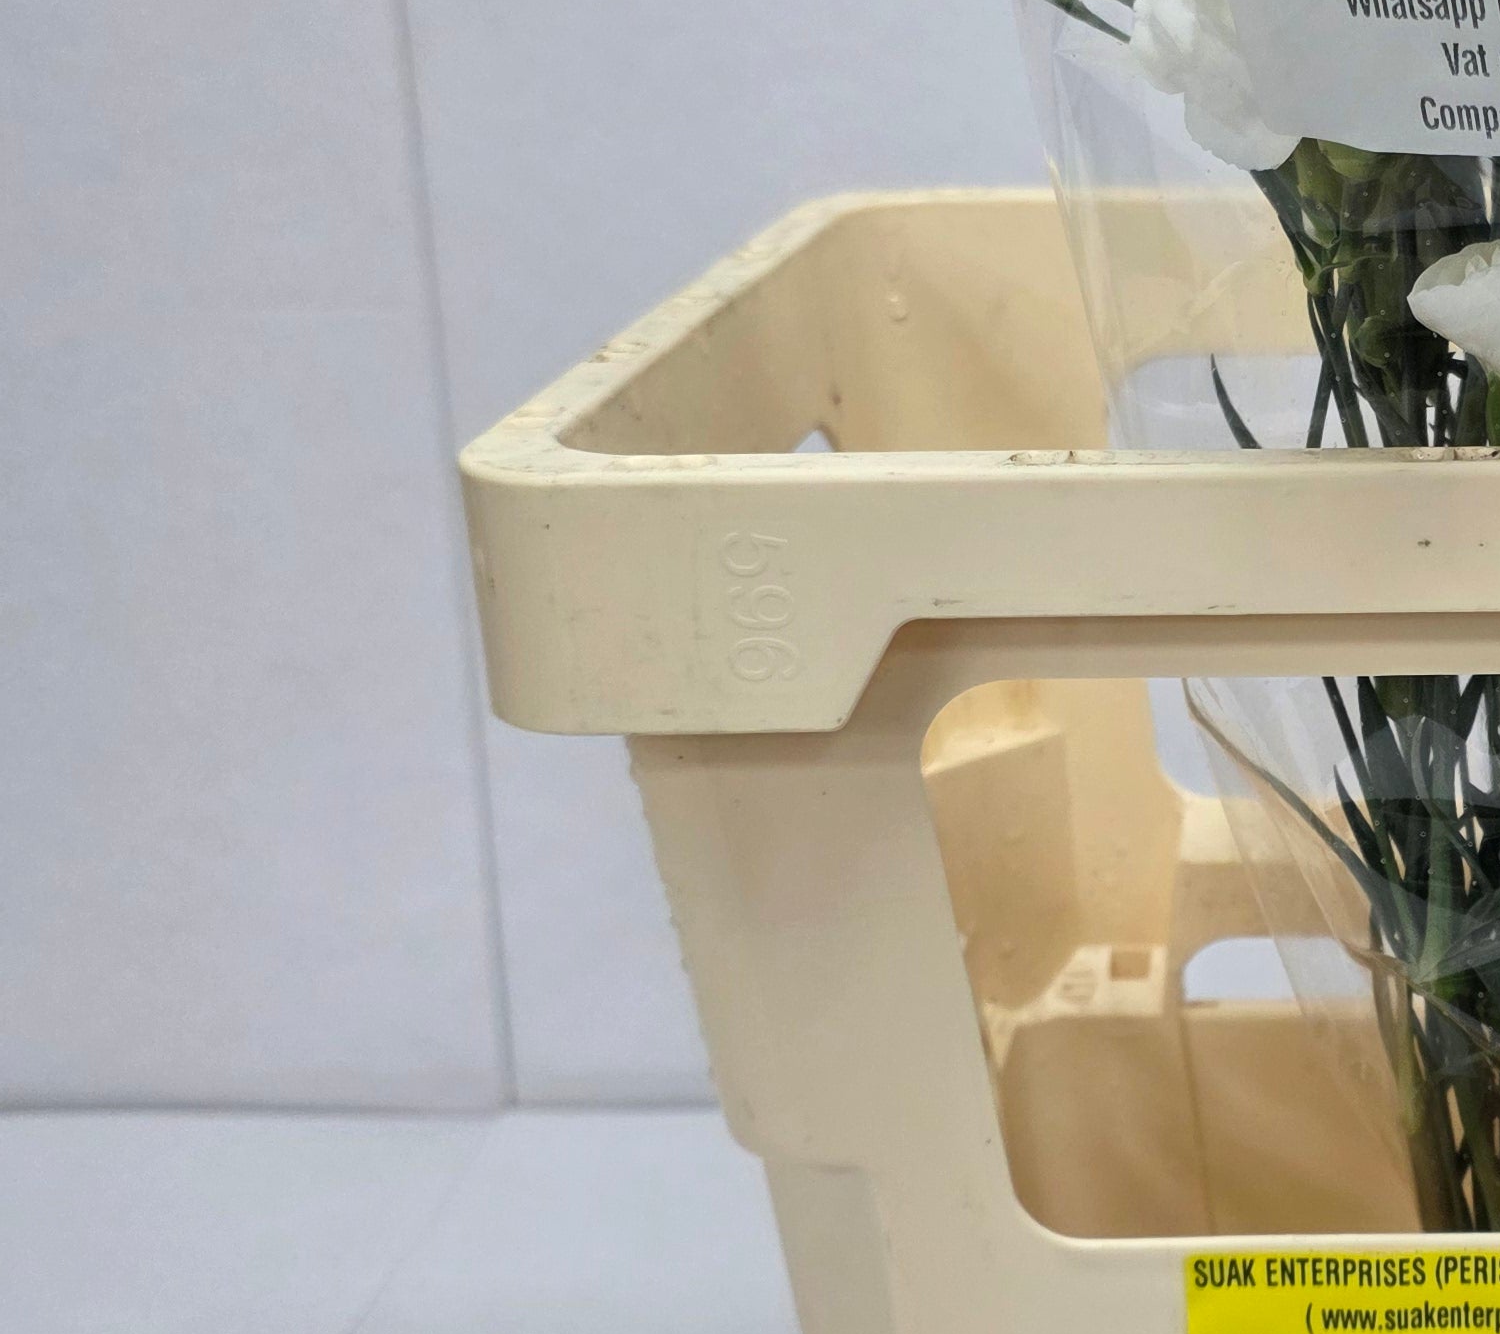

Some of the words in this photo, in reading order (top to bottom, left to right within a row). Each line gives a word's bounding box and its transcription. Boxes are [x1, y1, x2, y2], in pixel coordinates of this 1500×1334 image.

[1441, 43, 1490, 77] Vat
[1193, 1258, 1256, 1288] SUAK
[1266, 1257, 1426, 1287] ENTERPRISES
